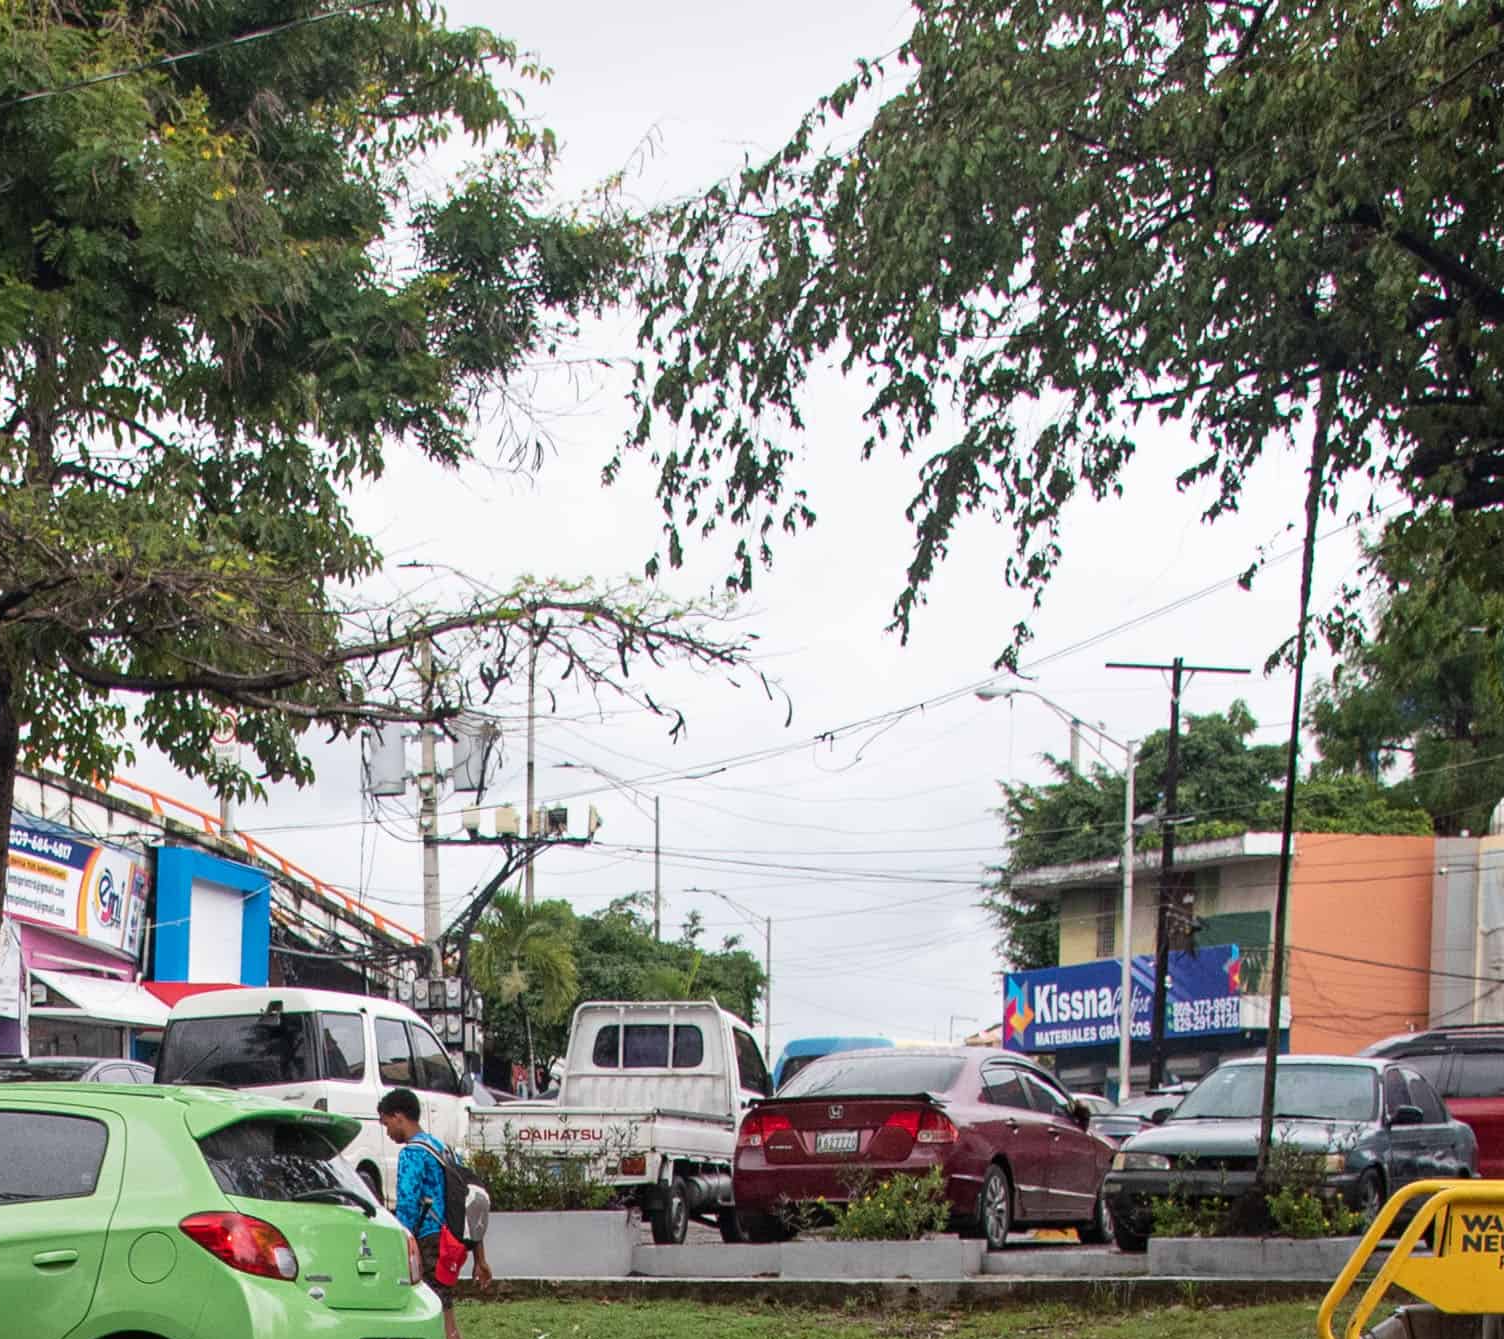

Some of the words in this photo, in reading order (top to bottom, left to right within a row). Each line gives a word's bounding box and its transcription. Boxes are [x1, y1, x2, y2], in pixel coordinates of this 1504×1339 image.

[1034, 984, 1114, 1025] Kissna
[1035, 1026, 1097, 1047] MATERIALES
[519, 1129, 603, 1141] DAIHATSU
